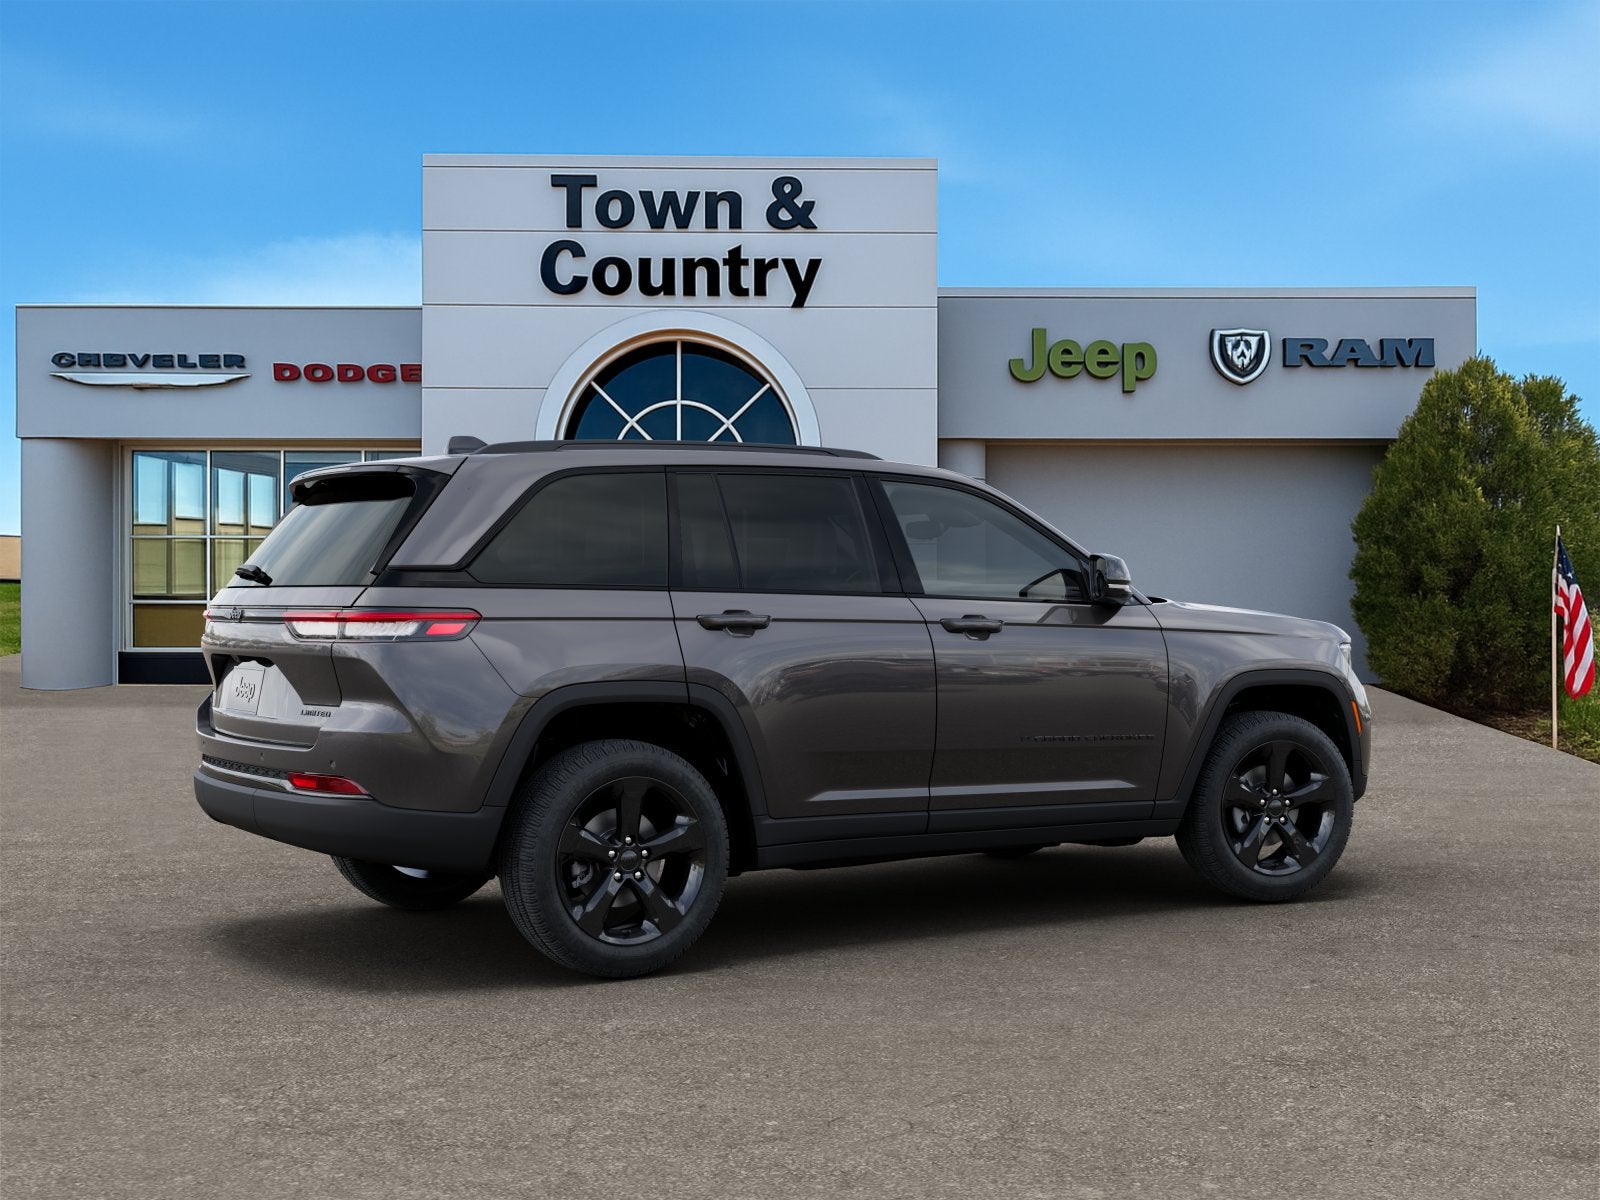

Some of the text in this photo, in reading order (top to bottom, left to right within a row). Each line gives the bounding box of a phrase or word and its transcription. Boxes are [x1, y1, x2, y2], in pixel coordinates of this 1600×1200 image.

[550, 174, 818, 229] Town &
[540, 239, 822, 308] Country
[273, 362, 422, 383] DODGE
[1009, 328, 1157, 393] Jeep
[1282, 337, 1435, 368] RAM
